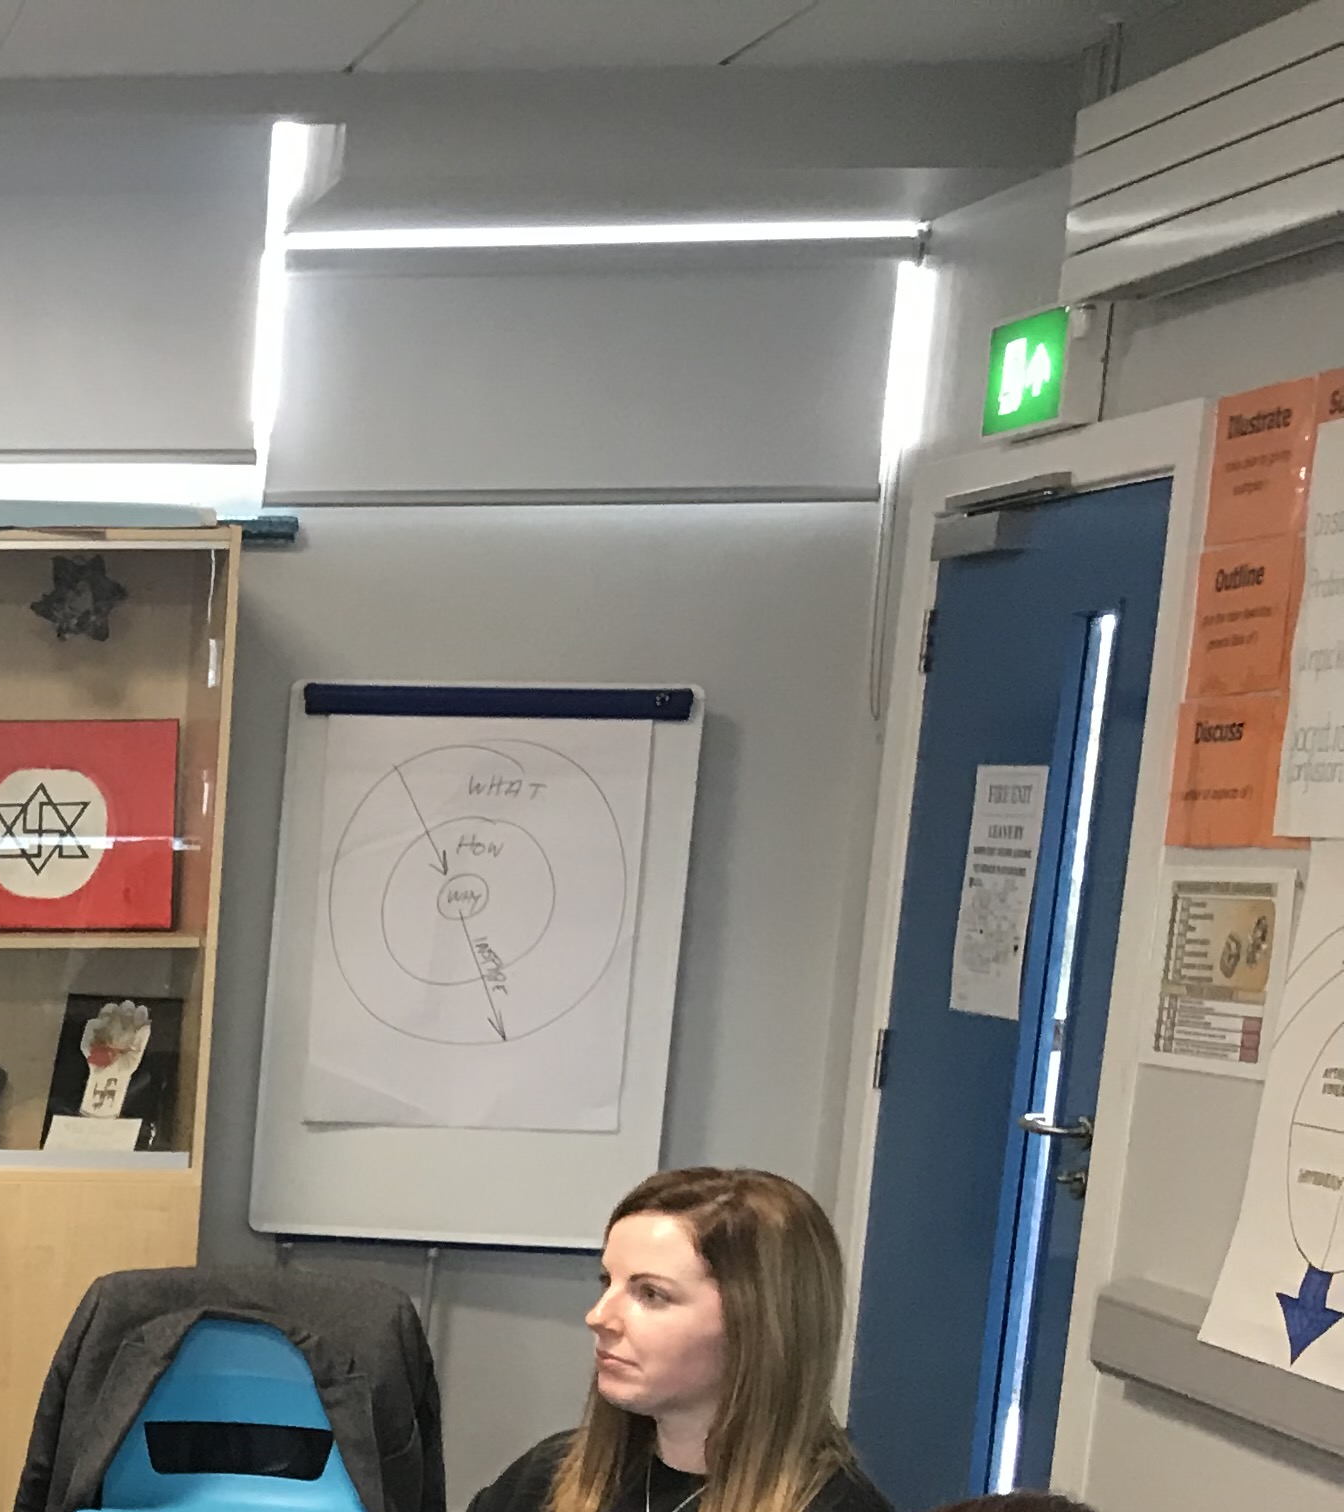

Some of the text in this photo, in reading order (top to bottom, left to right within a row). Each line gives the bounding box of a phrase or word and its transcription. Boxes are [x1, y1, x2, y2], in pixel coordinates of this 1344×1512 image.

[1227, 407, 1293, 440] Illustrate
[1215, 564, 1265, 593] Outline
[1194, 719, 1246, 745] Discuss
[468, 775, 548, 801] WHAT
